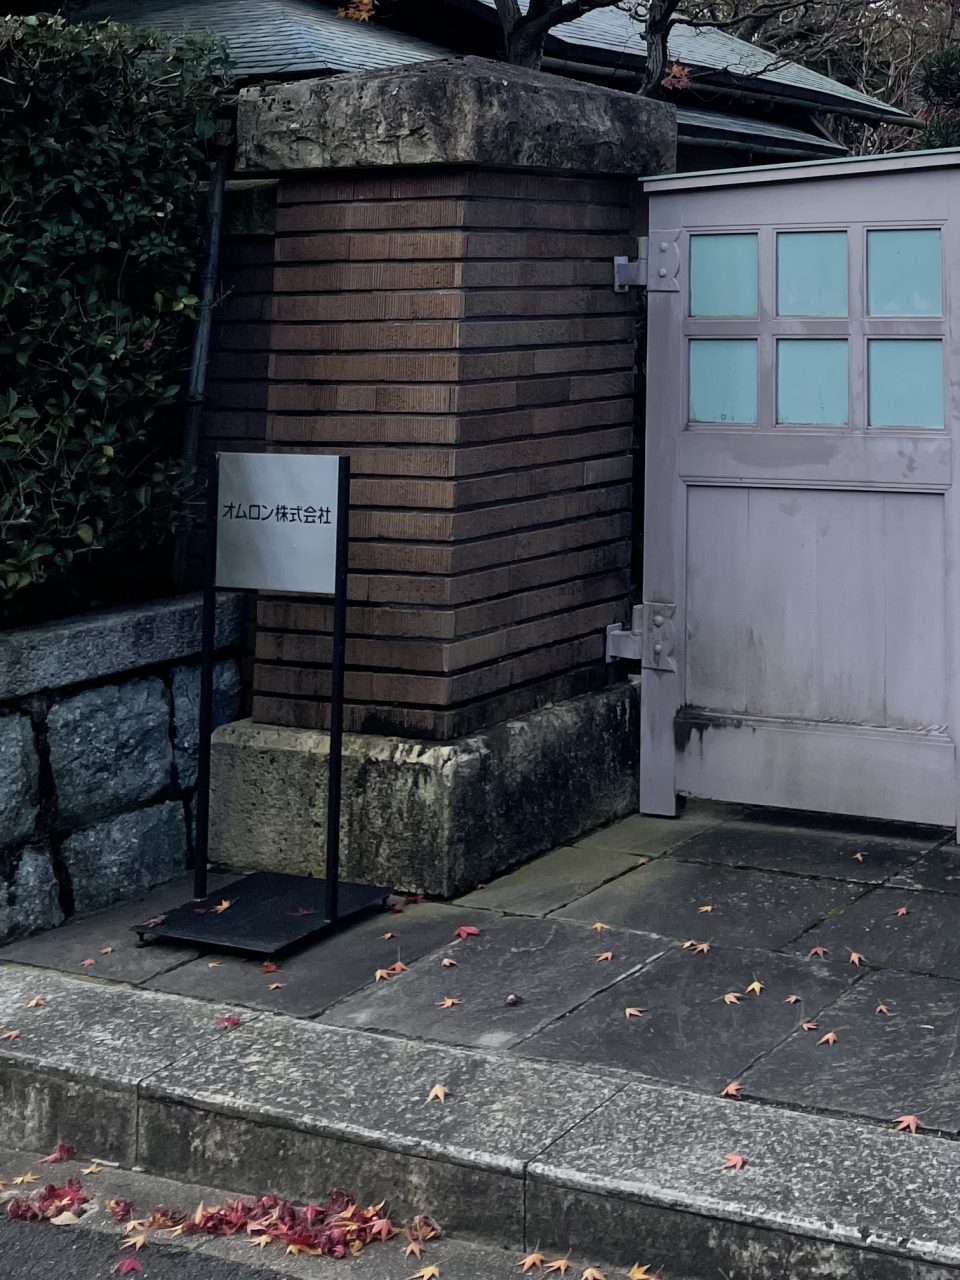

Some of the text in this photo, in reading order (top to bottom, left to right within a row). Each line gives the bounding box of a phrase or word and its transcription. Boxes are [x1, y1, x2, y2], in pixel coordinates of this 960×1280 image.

[222, 502, 332, 525] オムロン株式会社
